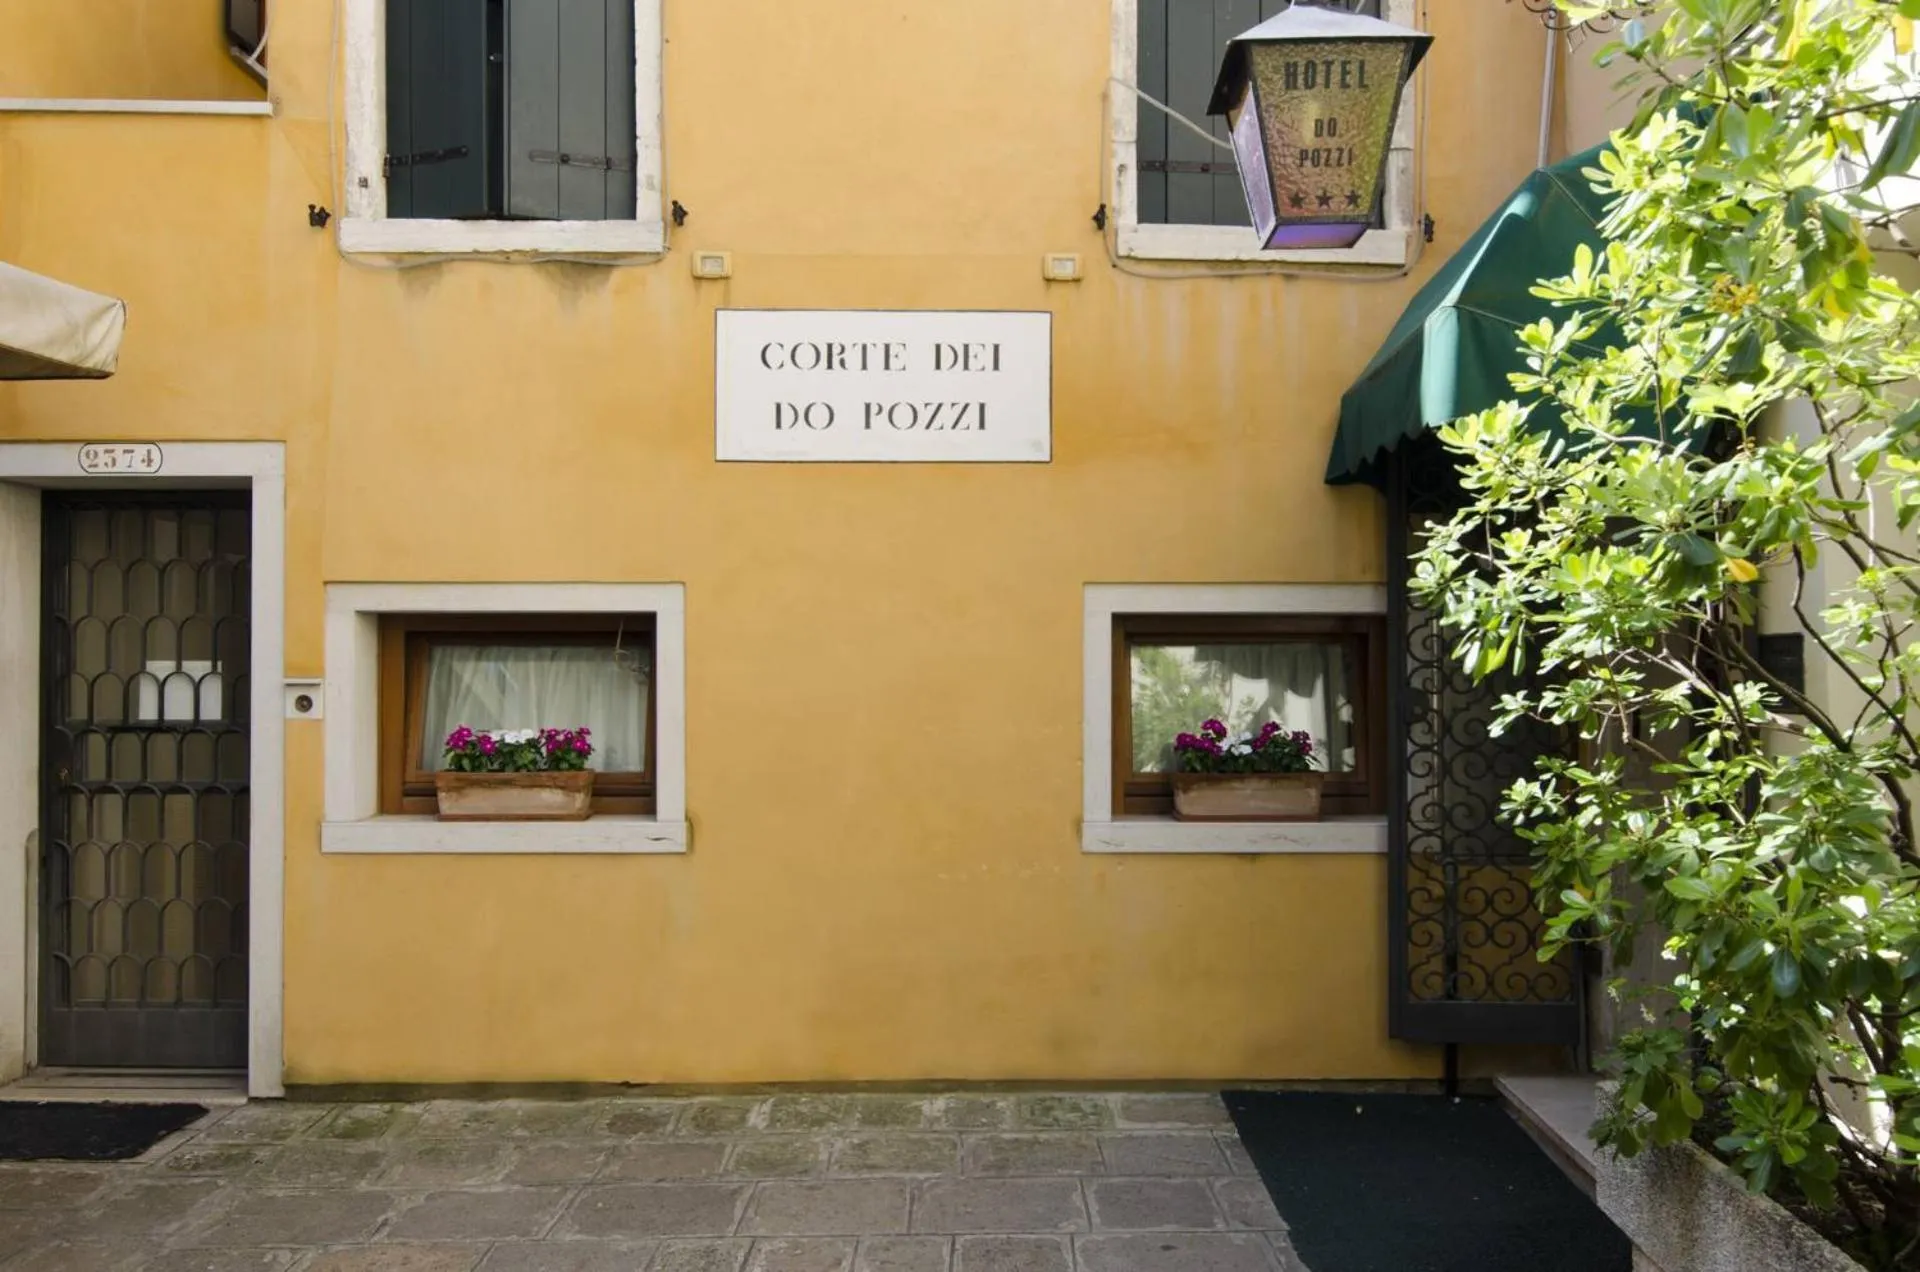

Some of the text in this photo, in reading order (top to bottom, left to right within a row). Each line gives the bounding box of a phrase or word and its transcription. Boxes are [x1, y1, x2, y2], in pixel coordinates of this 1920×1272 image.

[1284, 59, 1370, 90] HOTEL
[1314, 117, 1338, 137] DO
[1299, 148, 1353, 168] POZZI
[760, 342, 1001, 371] CORTE DEI
[774, 402, 987, 430] DO POZZI
